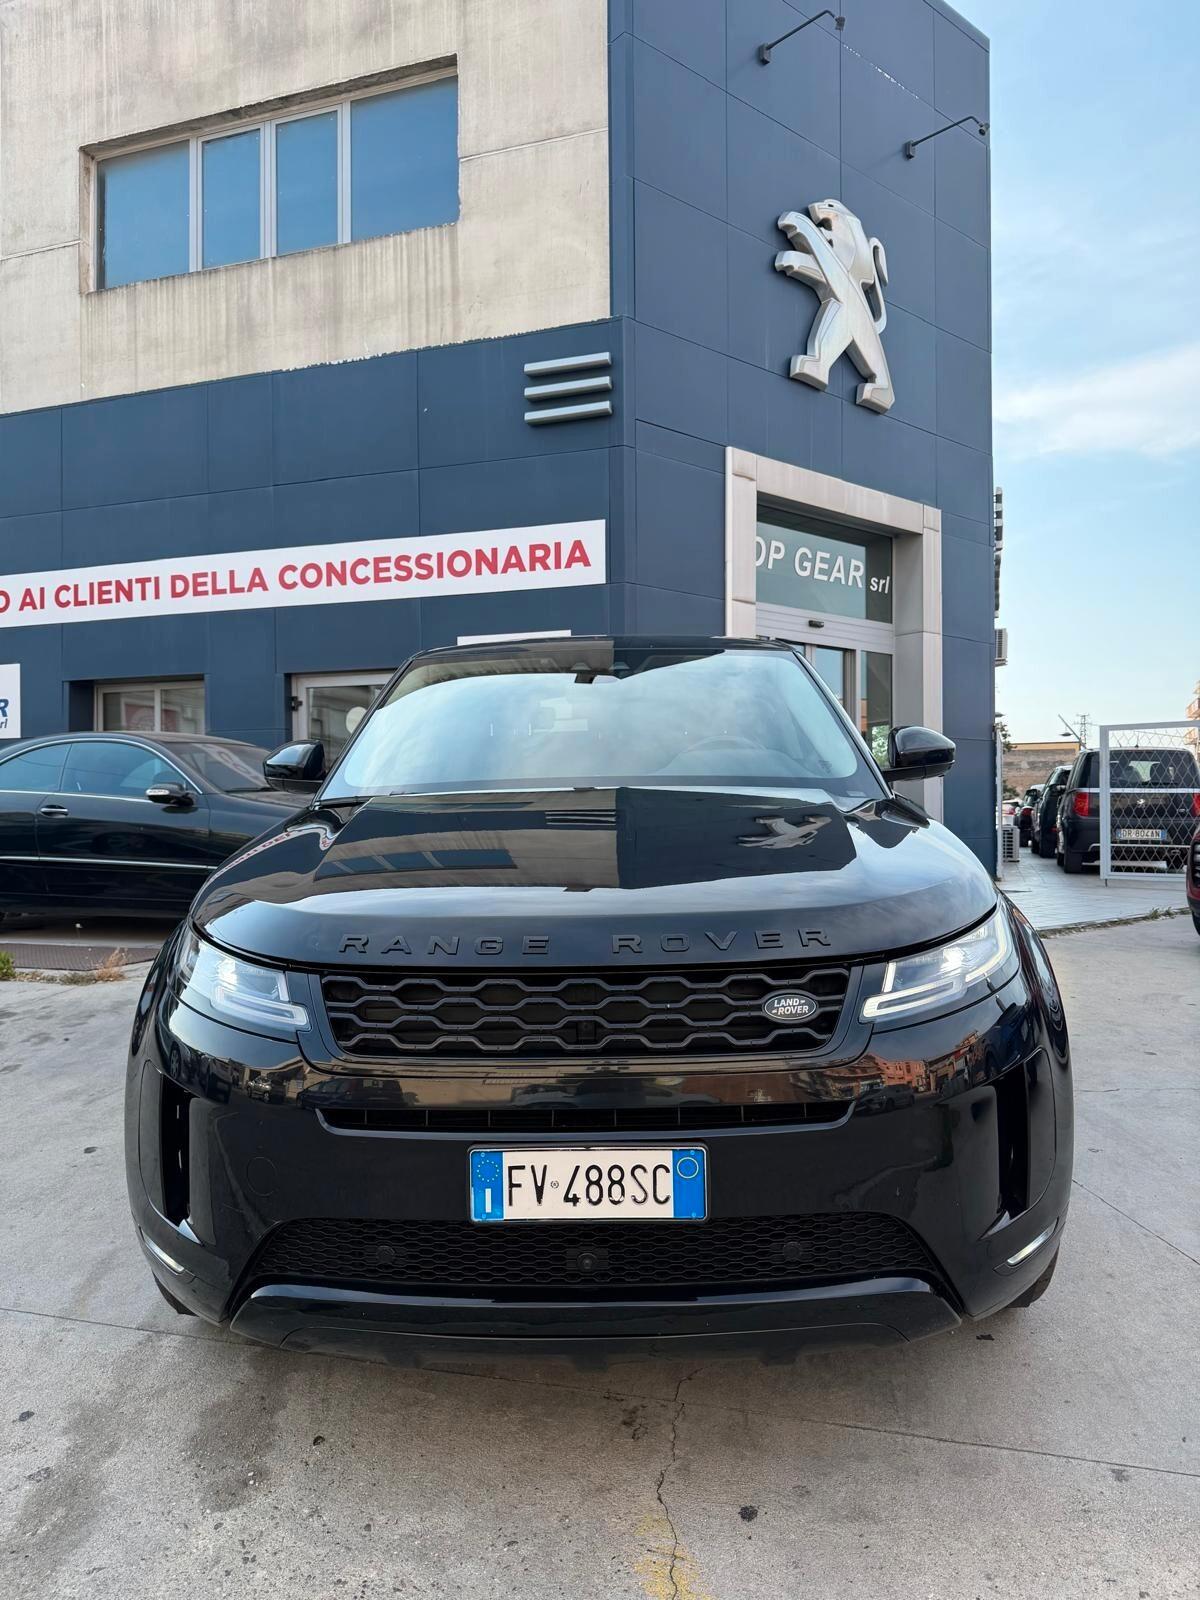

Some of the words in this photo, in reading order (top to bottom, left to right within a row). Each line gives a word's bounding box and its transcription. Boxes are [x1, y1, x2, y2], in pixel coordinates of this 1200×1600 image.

[19, 587, 45, 611] AI
[54, 576, 160, 609] CLIENTI
[170, 567, 268, 599] DELLA
[278, 539, 592, 591] CONCESSIONARIA
[794, 547, 865, 588] GEAR
[869, 576, 890, 594] srl
[338, 934, 551, 957] RANGE
[611, 928, 832, 955] ROVER
[774, 998, 799, 1007] LAND
[777, 1005, 809, 1015] ROVER
